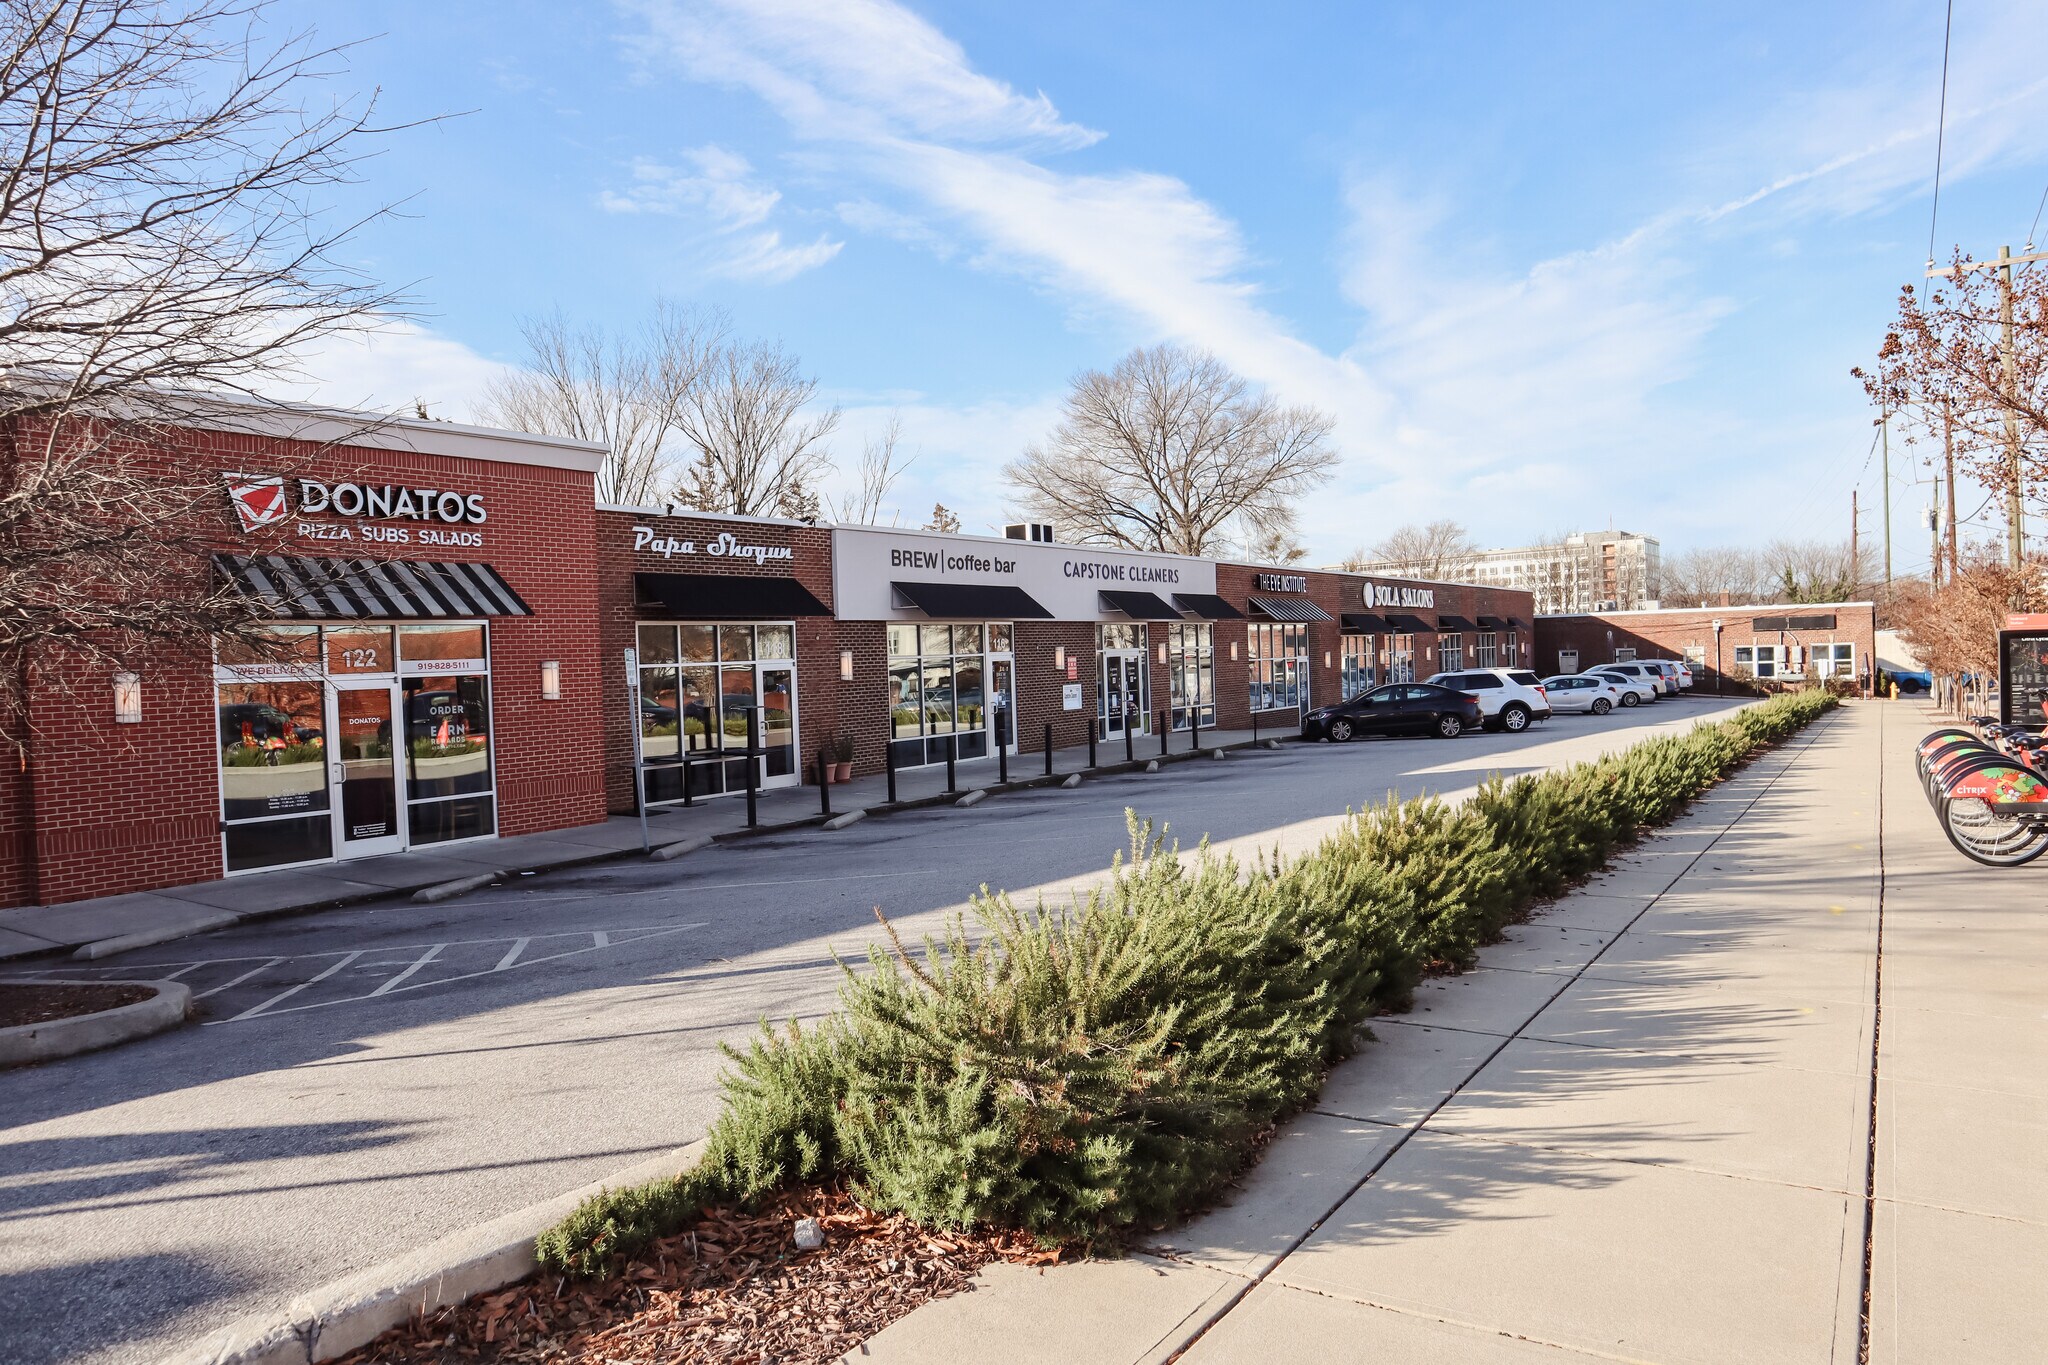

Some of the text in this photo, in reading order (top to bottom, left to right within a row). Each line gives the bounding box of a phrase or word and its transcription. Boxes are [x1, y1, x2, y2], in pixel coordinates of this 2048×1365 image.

[299, 479, 487, 524] DONATOS
[298, 523, 483, 547] PIZZA SUBS SALADS
[631, 526, 794, 566] Papa Shogun
[891, 549, 1016, 574] BREW coffee bar
[1063, 561, 1179, 584] CAPSTONE CLEANERS
[1259, 574, 1307, 593] THE EYE INSTITUTE
[1375, 585, 1434, 609] SOLA SALONS
[993, 638, 1006, 649] 116
[342, 649, 377, 668] 122
[417, 661, 470, 670] 919-828-5111
[237, 665, 305, 675] WE DELIVER
[430, 705, 464, 715] ORDER
[349, 717, 381, 725] DONATOS
[430, 724, 465, 737] ERN
[431, 736, 466, 745] REARDS
